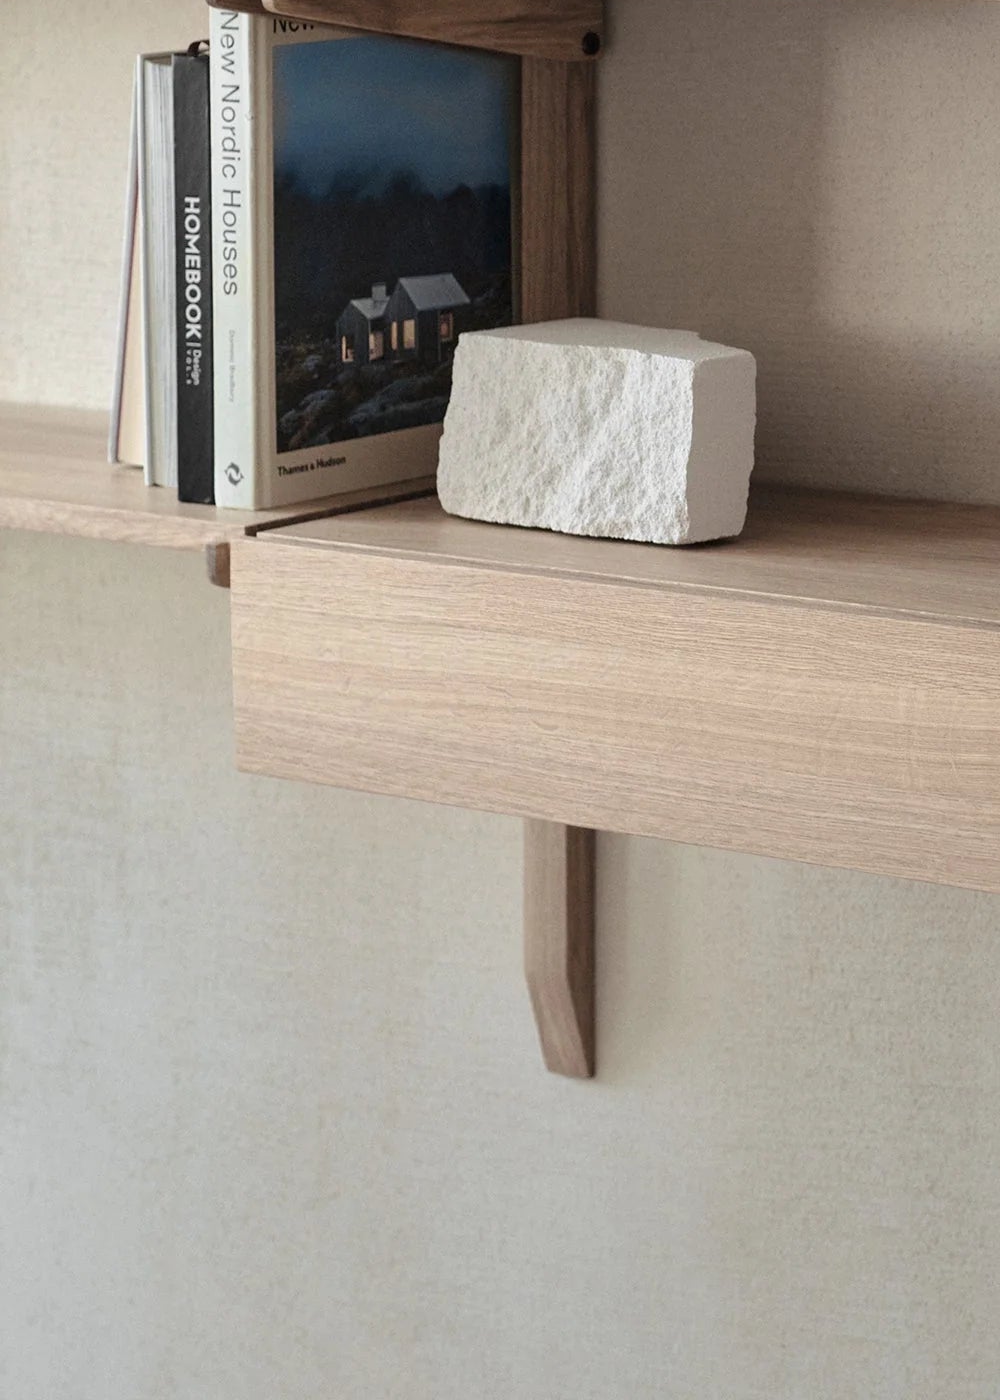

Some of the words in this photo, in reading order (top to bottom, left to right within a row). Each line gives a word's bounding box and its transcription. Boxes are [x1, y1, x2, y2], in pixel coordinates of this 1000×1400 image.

[220, 11, 240, 75] New
[221, 84, 241, 178] Nordic
[184, 196, 202, 339] HOMEBOOK
[222, 188, 242, 296] Houses
[191, 349, 202, 386] Design
